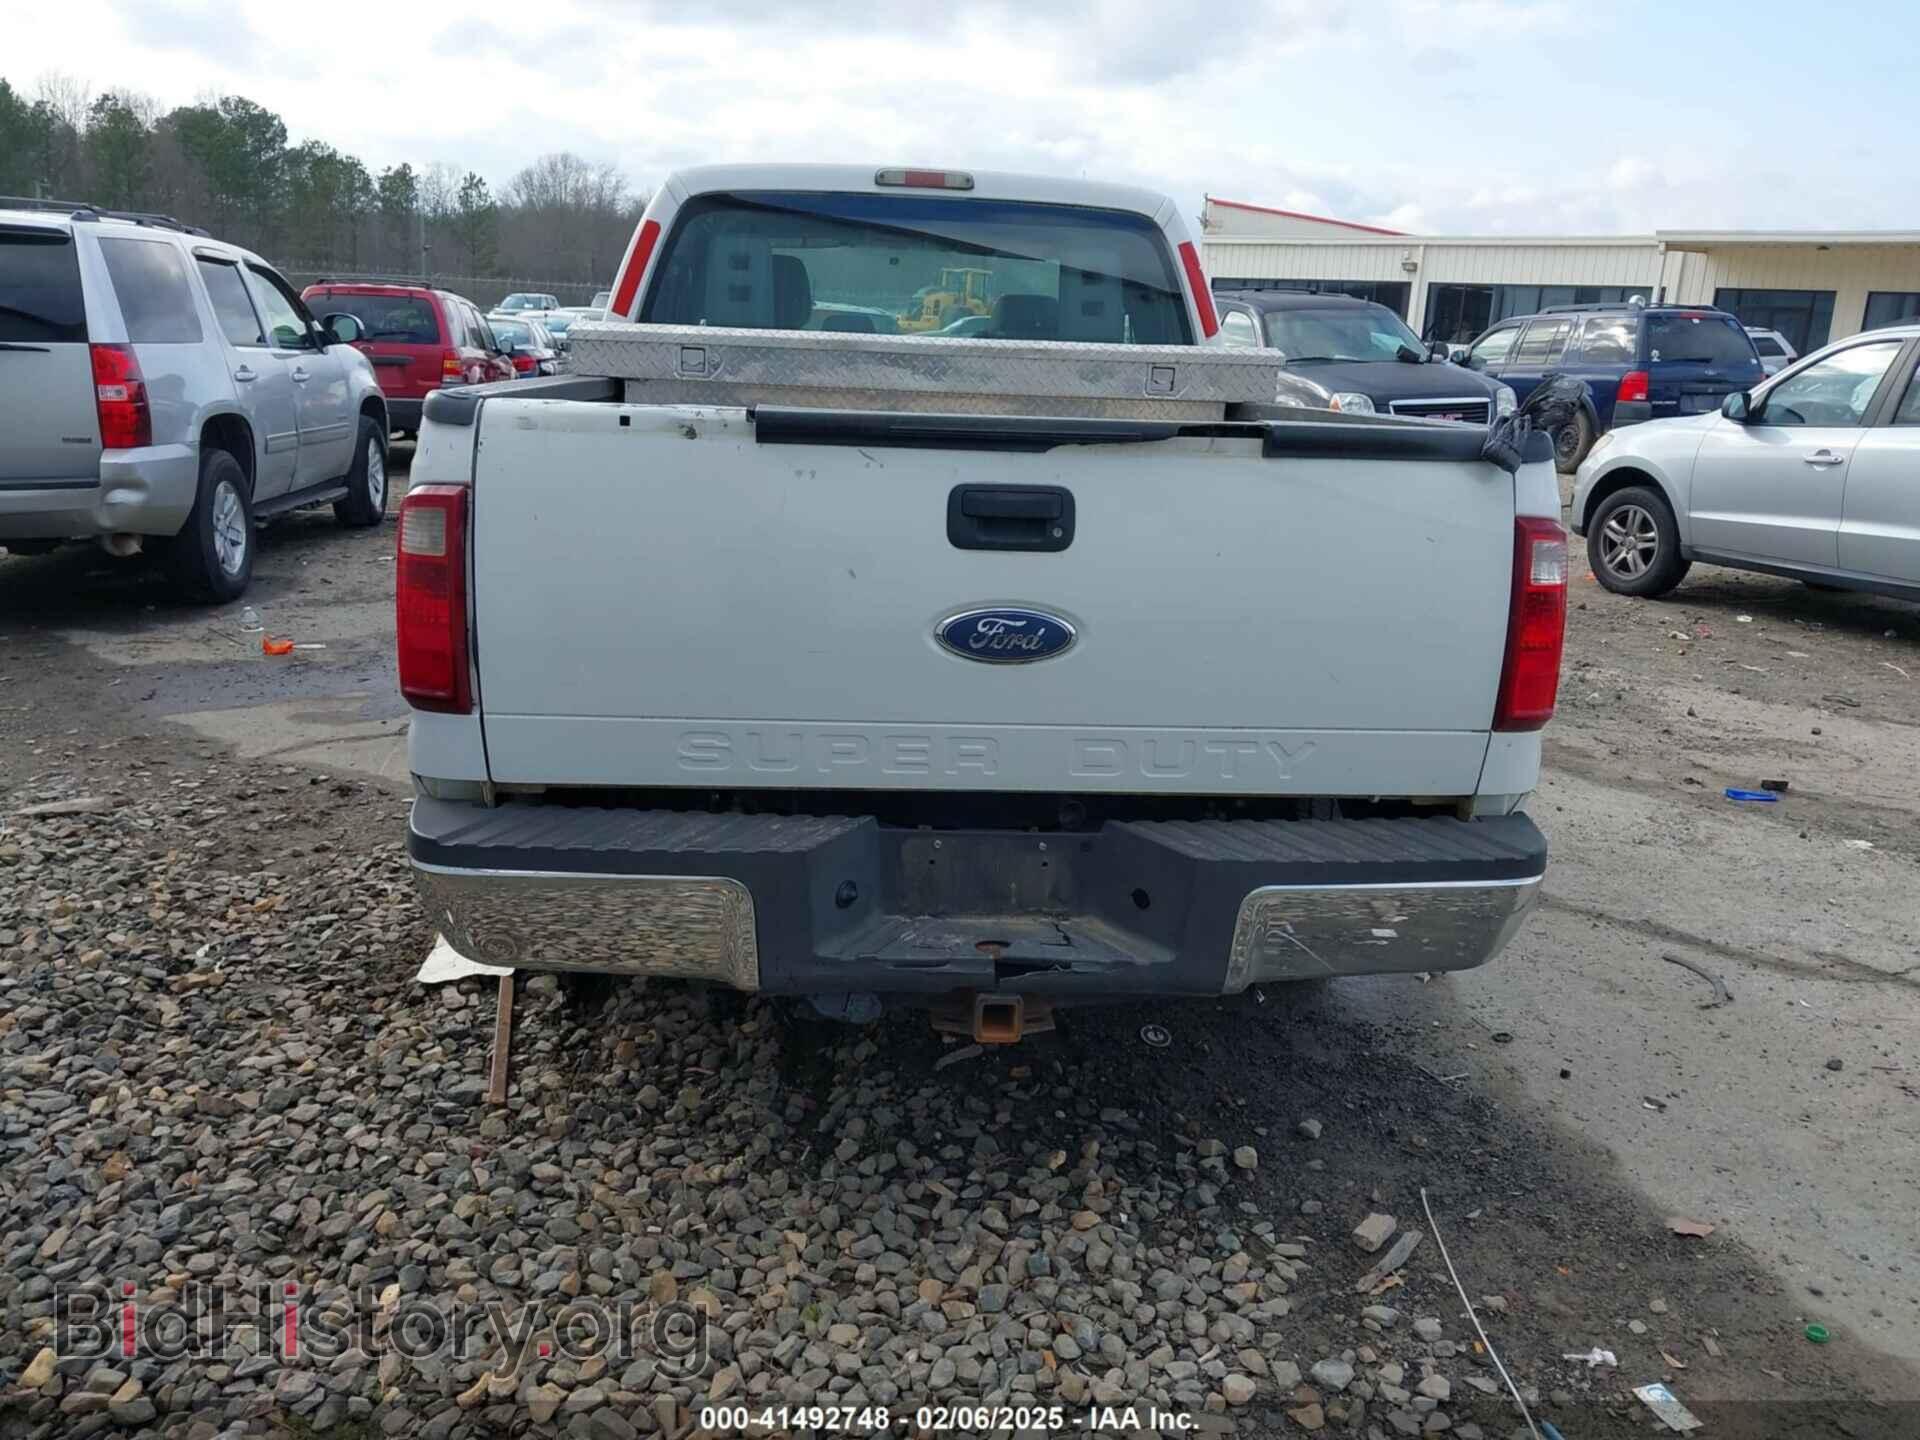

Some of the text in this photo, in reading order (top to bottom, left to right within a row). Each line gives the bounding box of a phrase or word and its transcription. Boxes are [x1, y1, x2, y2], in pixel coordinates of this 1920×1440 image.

[968, 617, 1046, 650] Ford
[677, 731, 1317, 780] SUPER DUTY
